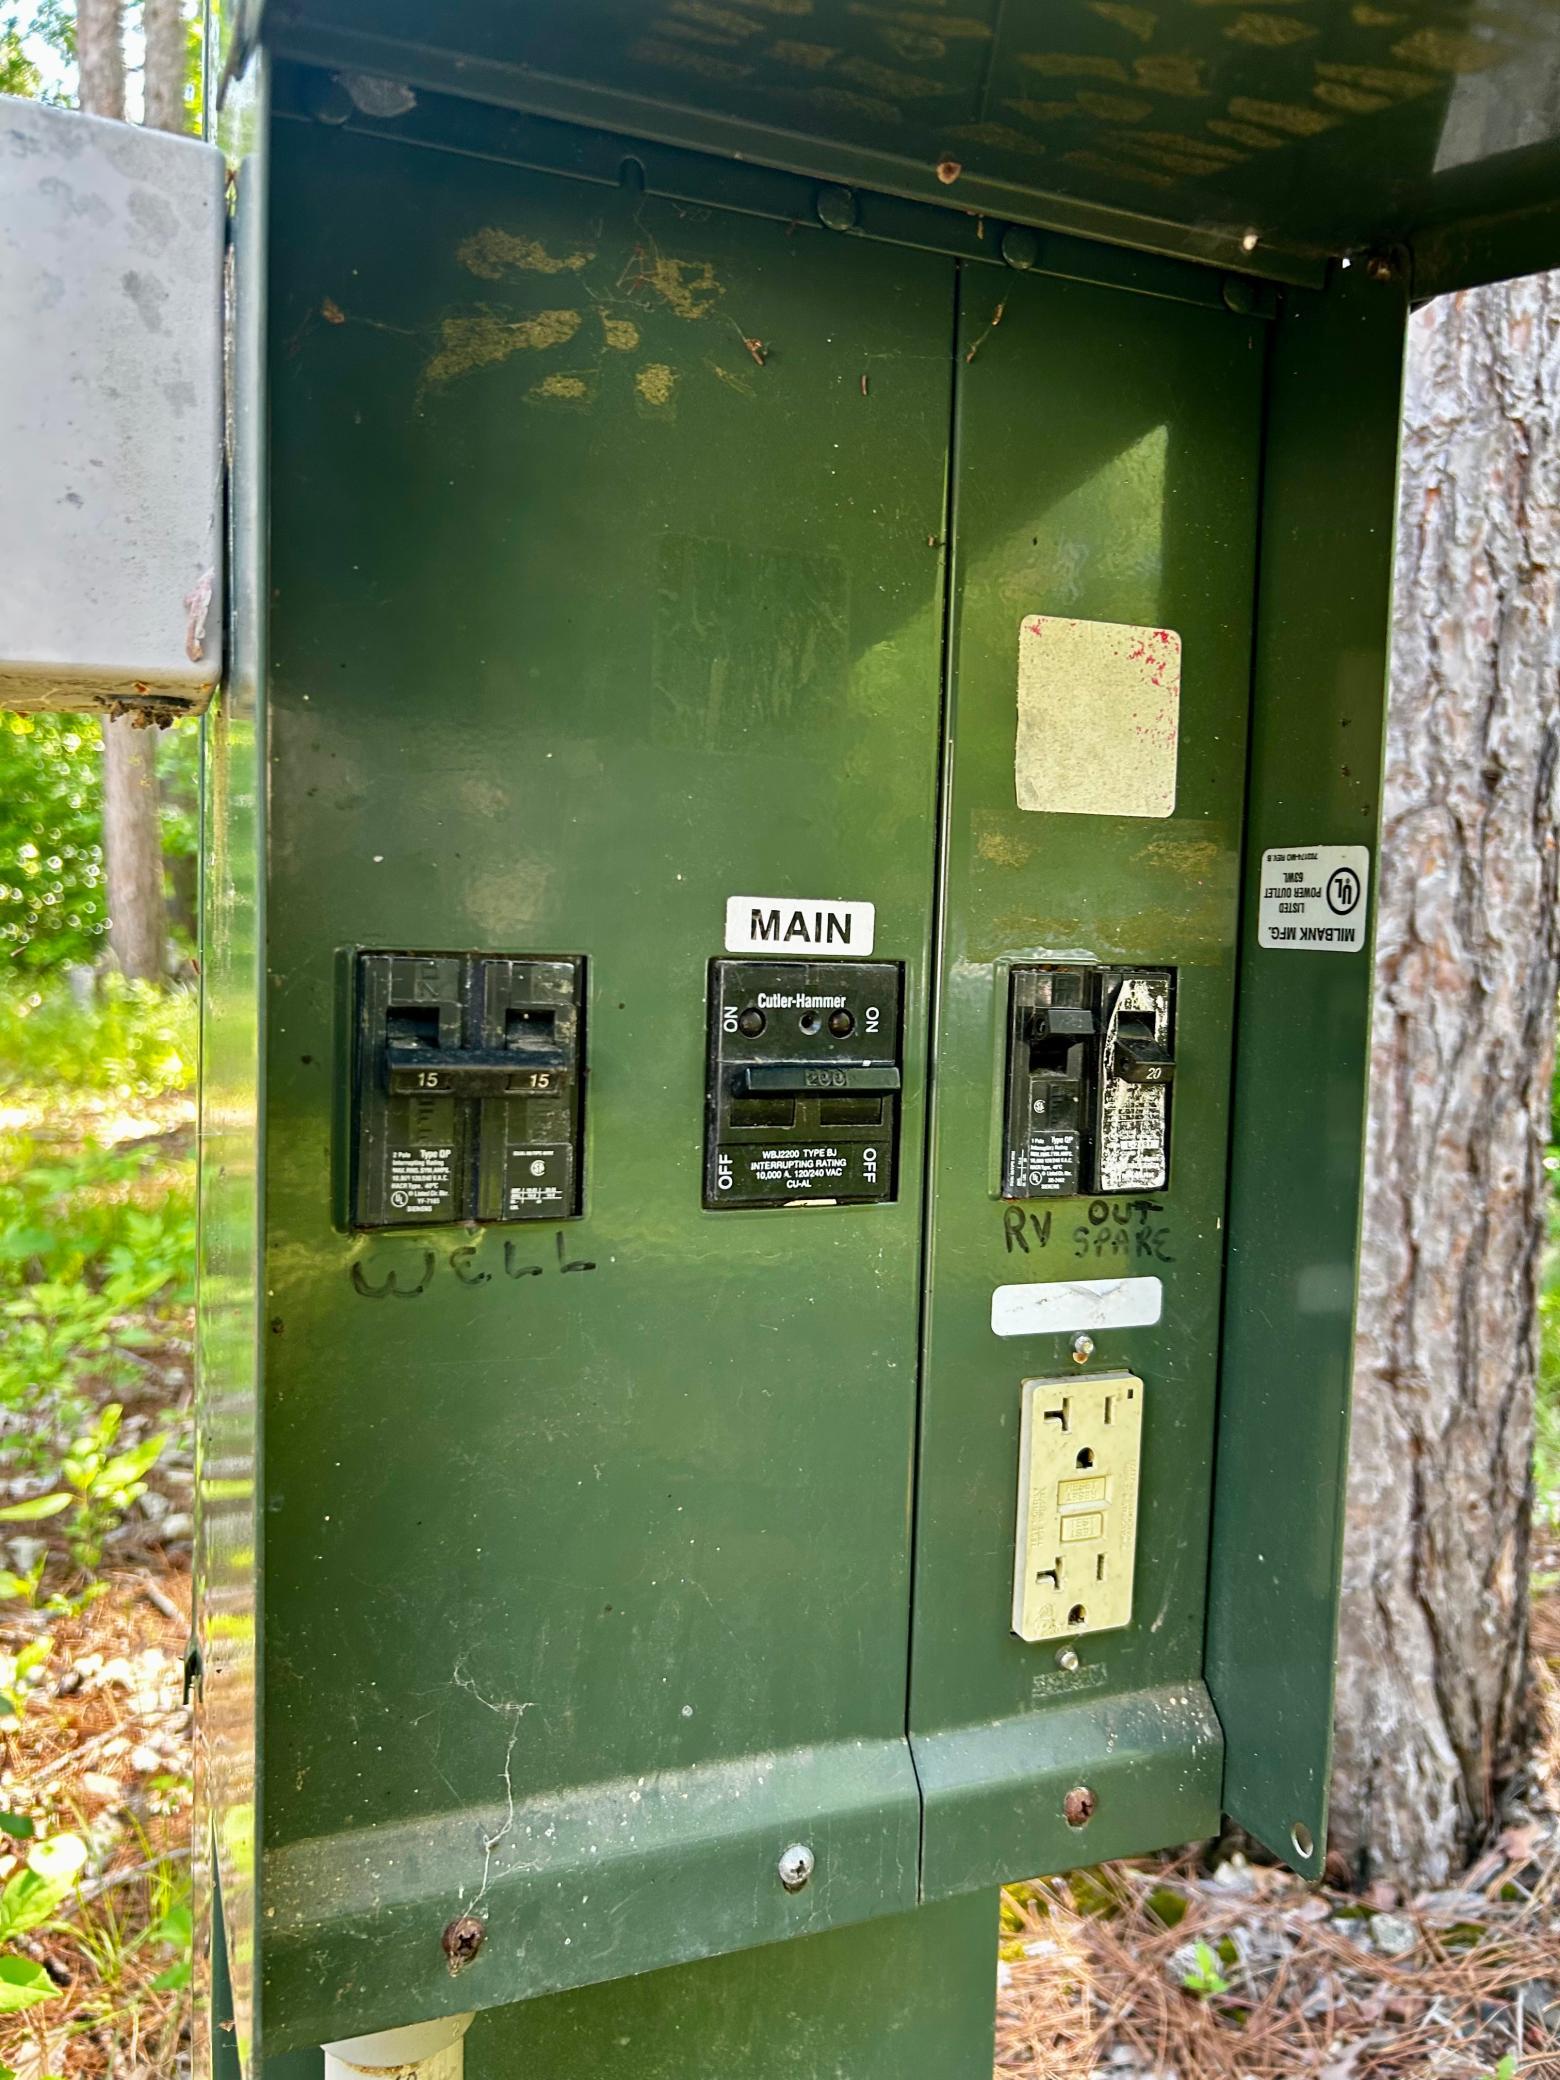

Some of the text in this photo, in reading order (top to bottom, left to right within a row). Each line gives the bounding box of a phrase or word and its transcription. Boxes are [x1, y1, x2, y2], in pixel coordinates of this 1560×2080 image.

[1264, 887, 1322, 898] POWER OUTLET
[1279, 902, 1305, 913] LISTED
[750, 908, 852, 945] MAIN
[1268, 926, 1355, 942] MILBANK MFG.
[757, 992, 847, 1009] Cutler-Hammer
[723, 1006, 739, 1033] ON
[865, 1006, 880, 1033] ON
[417, 1072, 439, 1088] 15
[529, 1073, 551, 1089] 15
[1146, 1067, 1162, 1080] 20
[420, 1149, 438, 1160] Type
[762, 1148, 838, 1160] WBJ2200 TYPE BJ
[718, 1154, 733, 1190] OFF
[750, 1158, 847, 1170] INTERRUPTING RATING
[863, 1148, 877, 1183] OFF
[756, 1170, 782, 1180] 10,000
[794, 1169, 825, 1178] 120/240
[825, 1167, 843, 1177] VAC
[786, 1180, 812, 1189] CU-AL
[1088, 1199, 1164, 1226] OUT
[1003, 1205, 1052, 1254] RV
[1072, 1226, 1176, 1263] SPARE
[351, 1230, 597, 1299] WELL
